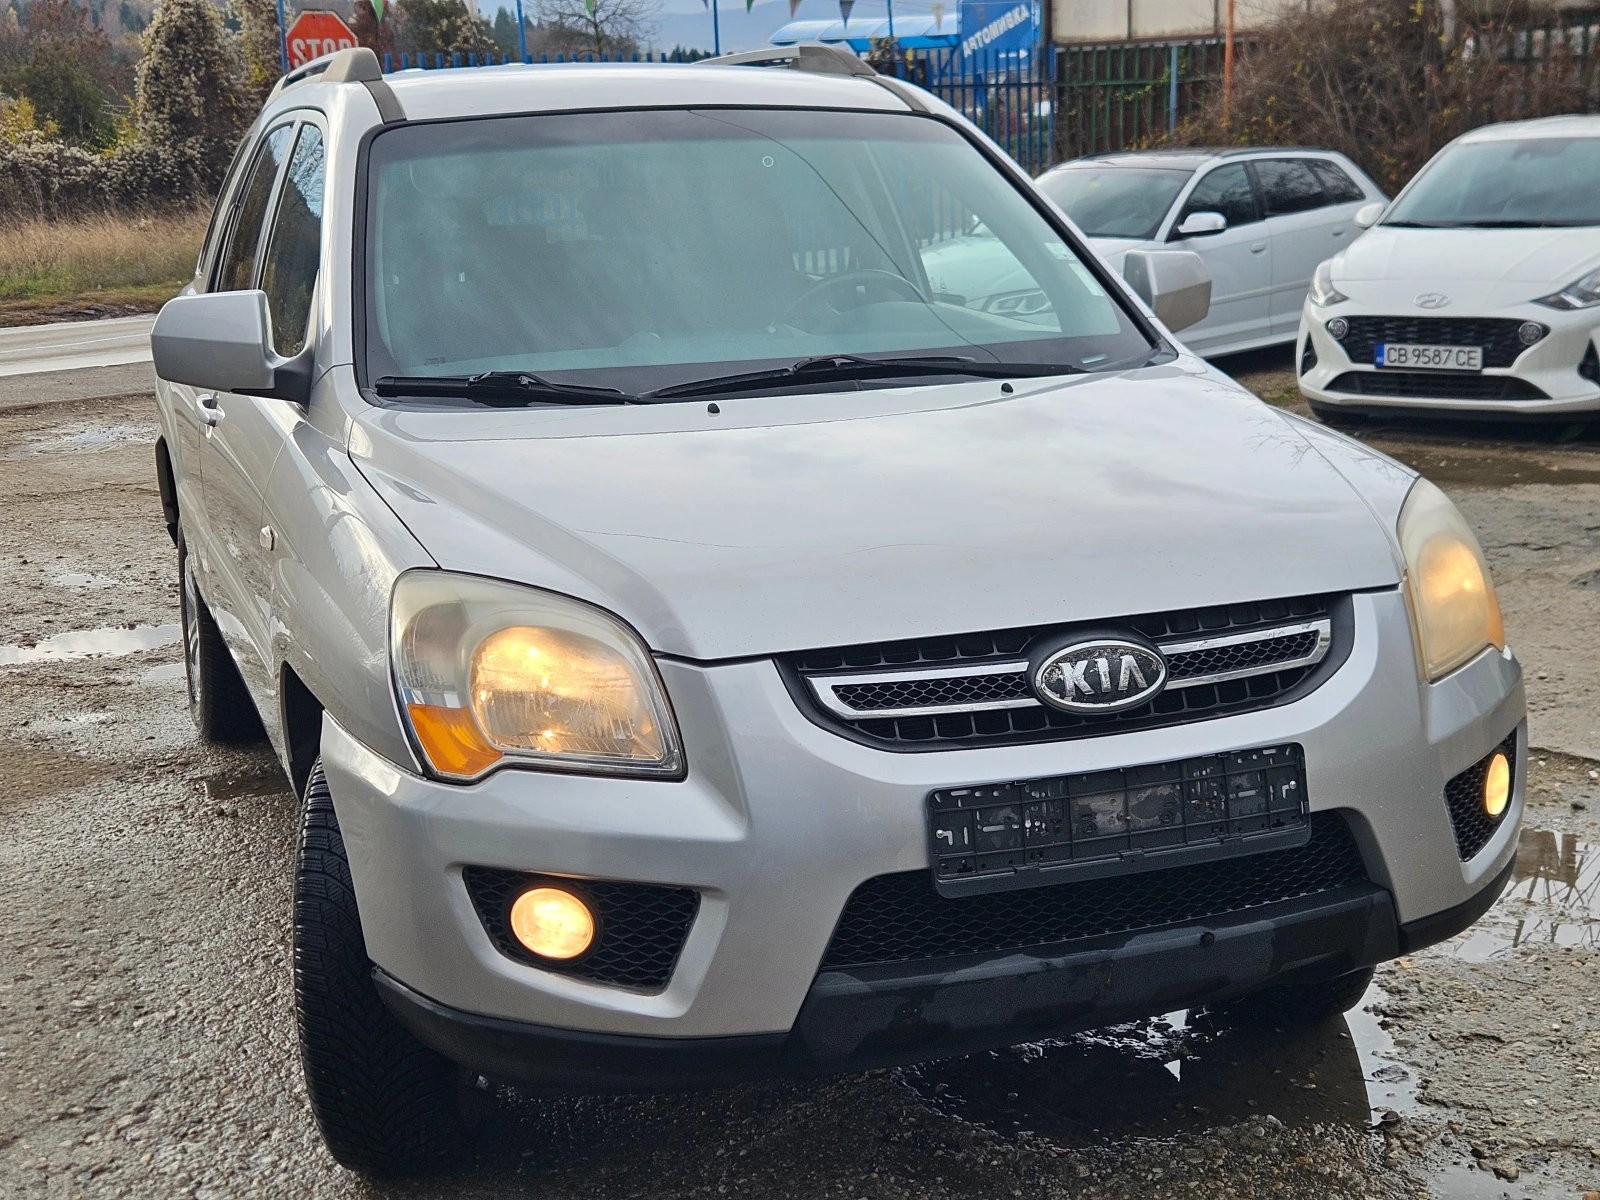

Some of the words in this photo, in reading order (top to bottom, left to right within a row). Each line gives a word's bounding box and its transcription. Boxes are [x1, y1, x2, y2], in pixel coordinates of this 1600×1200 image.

[963, 4, 1030, 58] АВТОМИВКА
[1387, 347, 1407, 364] CB
[1411, 348, 1452, 366] 9587
[1455, 349, 1478, 367] CE
[1058, 654, 1148, 701] KIA
